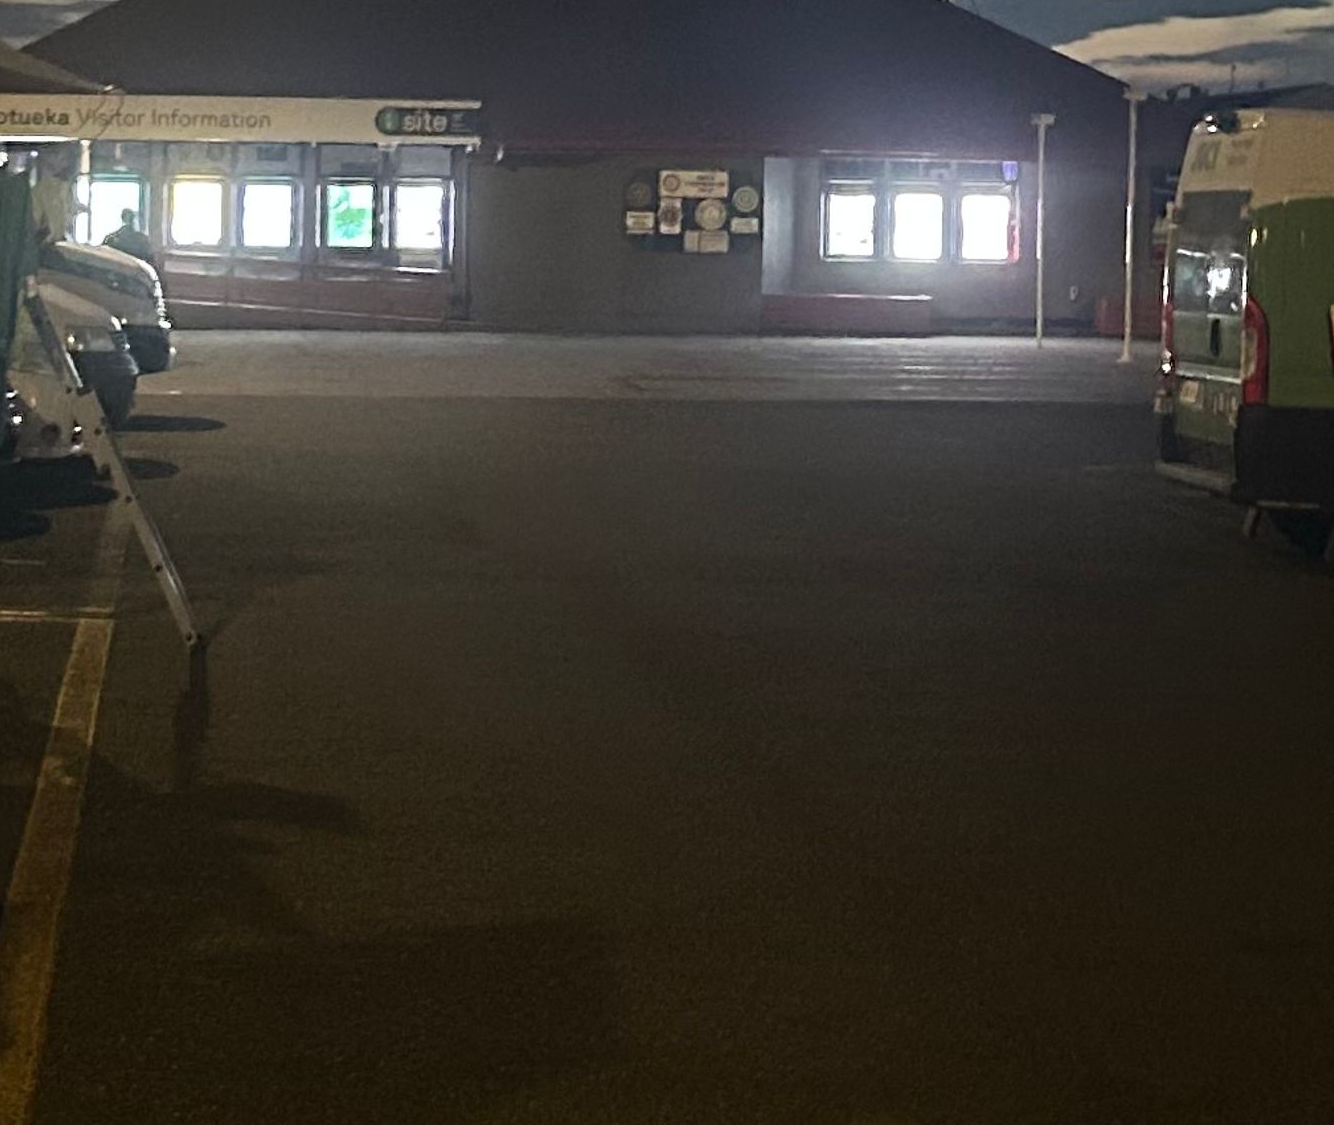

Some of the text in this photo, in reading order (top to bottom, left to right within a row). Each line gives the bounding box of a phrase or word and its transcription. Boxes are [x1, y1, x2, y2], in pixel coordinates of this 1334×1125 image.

[76, 108, 145, 126] Visitor
[152, 108, 271, 128] Information
[402, 108, 448, 133] site
